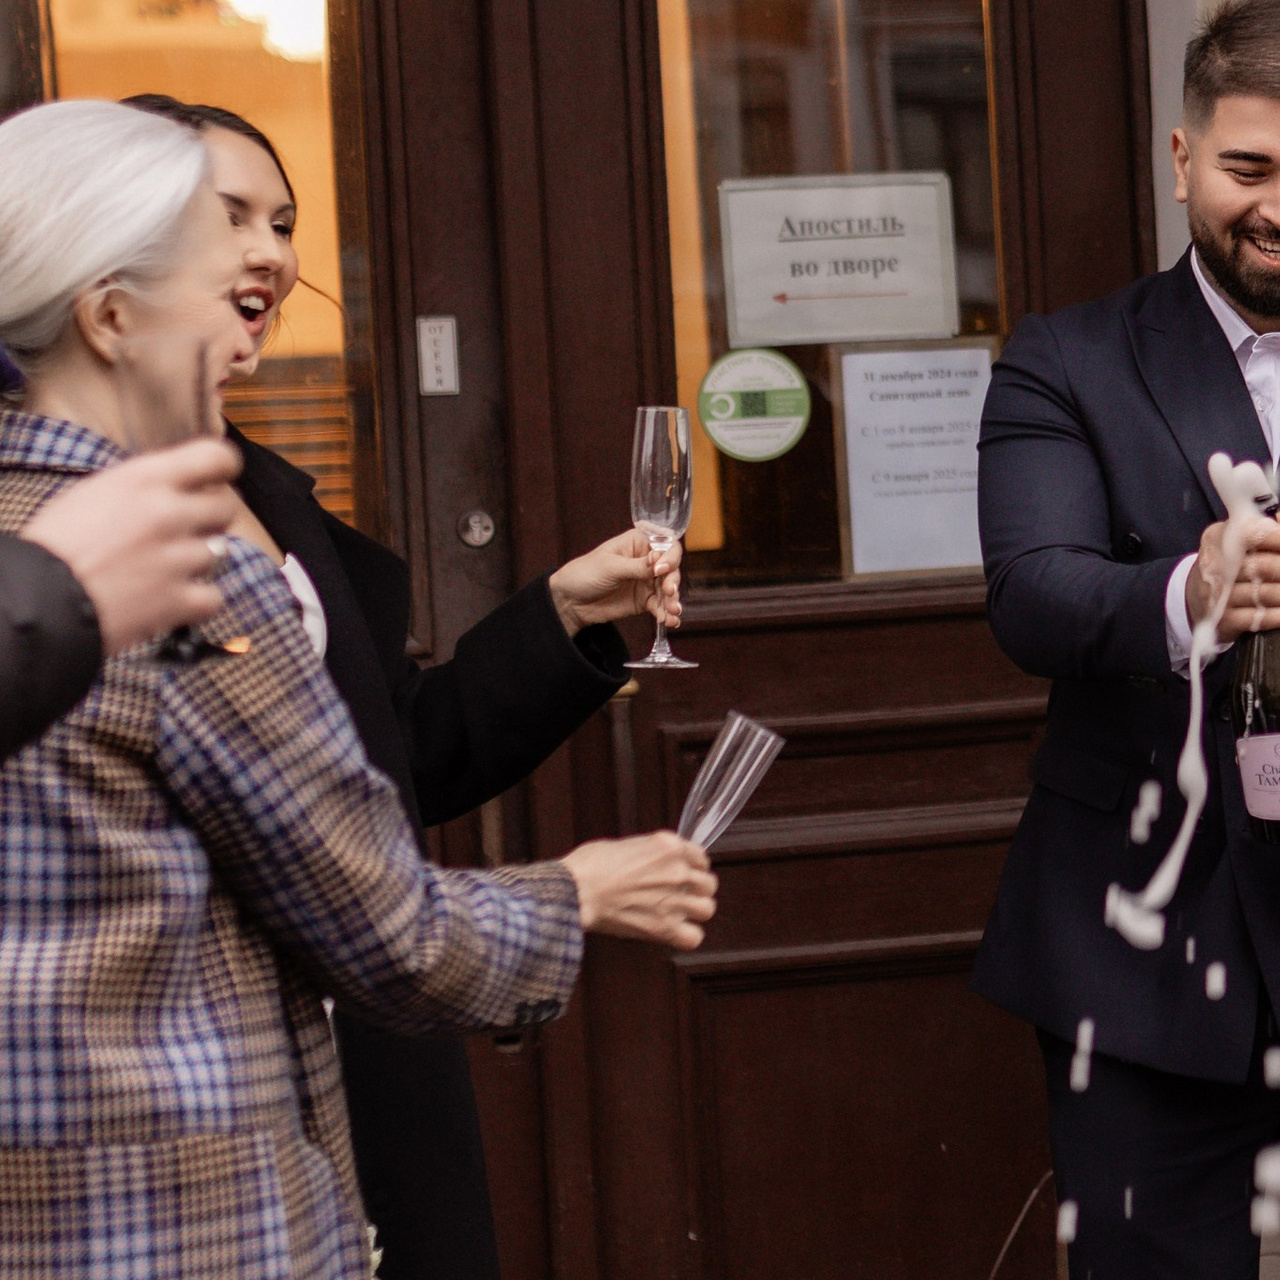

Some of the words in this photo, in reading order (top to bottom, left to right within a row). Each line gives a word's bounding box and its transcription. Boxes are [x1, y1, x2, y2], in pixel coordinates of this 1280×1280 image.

[779, 216, 904, 238] Апостиль
[790, 262, 819, 278] во
[826, 257, 899, 279] дворе
[879, 371, 924, 383] декабря
[954, 368, 979, 379] года
[869, 389, 942, 402] Санитарный
[946, 388, 971, 399] день
